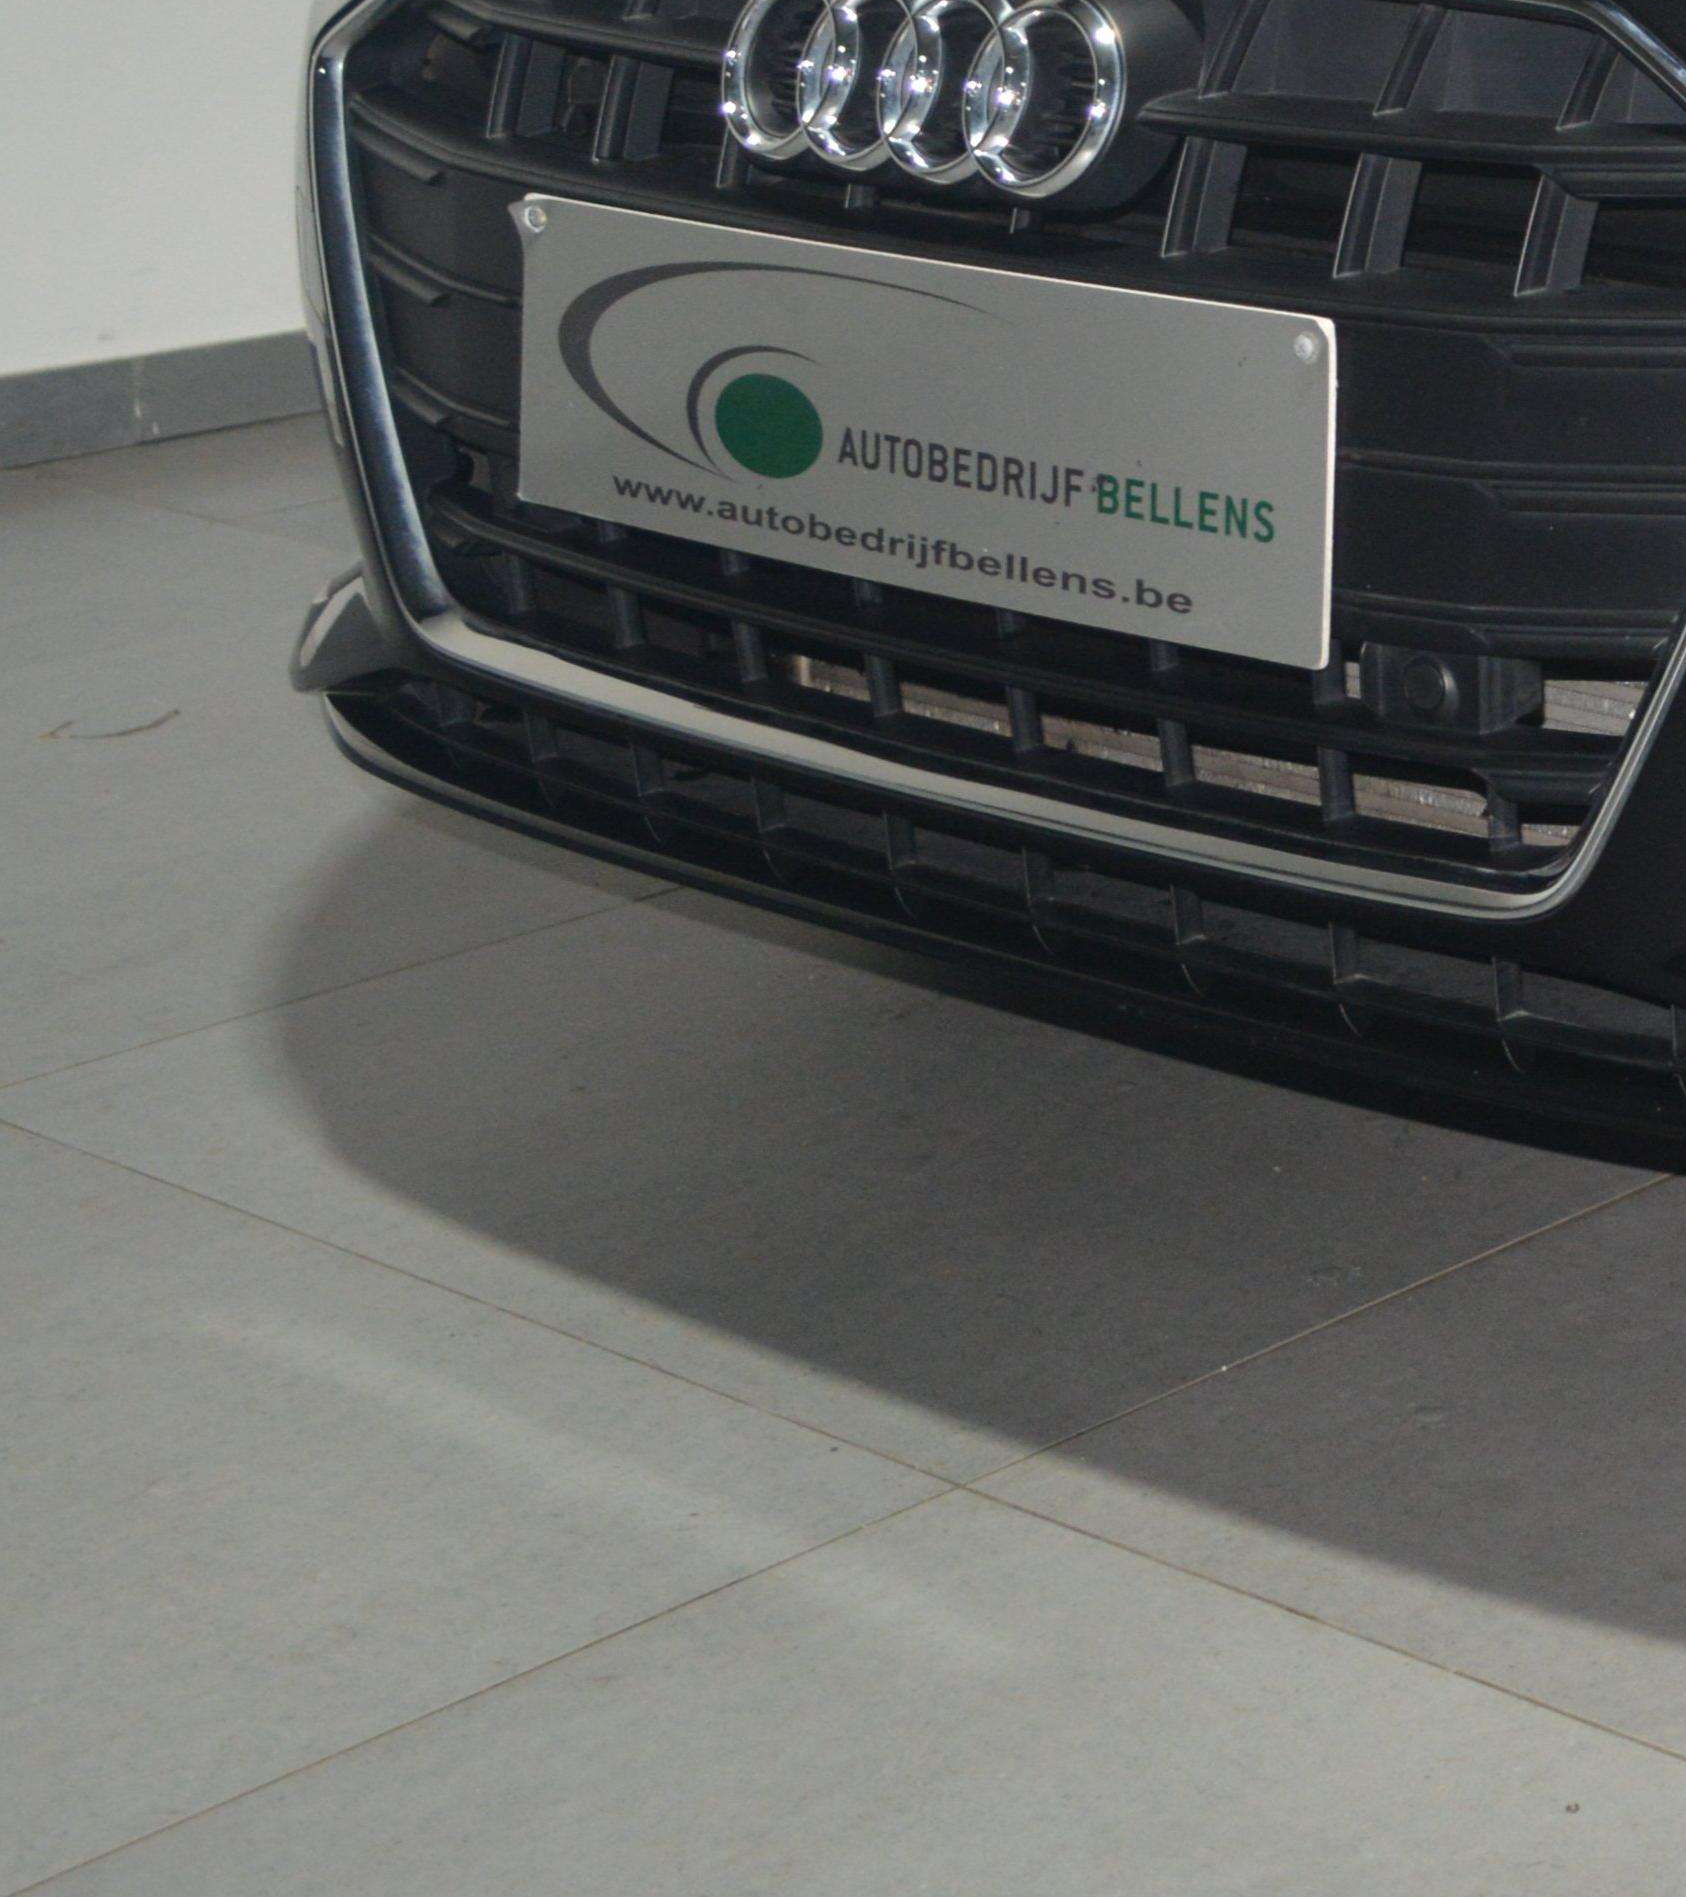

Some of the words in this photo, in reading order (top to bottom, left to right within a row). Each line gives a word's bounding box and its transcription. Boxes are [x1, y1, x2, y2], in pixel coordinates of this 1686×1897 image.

[612, 474, 1194, 616] www.autobedrijfbellens.be
[838, 427, 1085, 508] AUTOBEDRIJF
[1096, 473, 1276, 544] BELLENS
